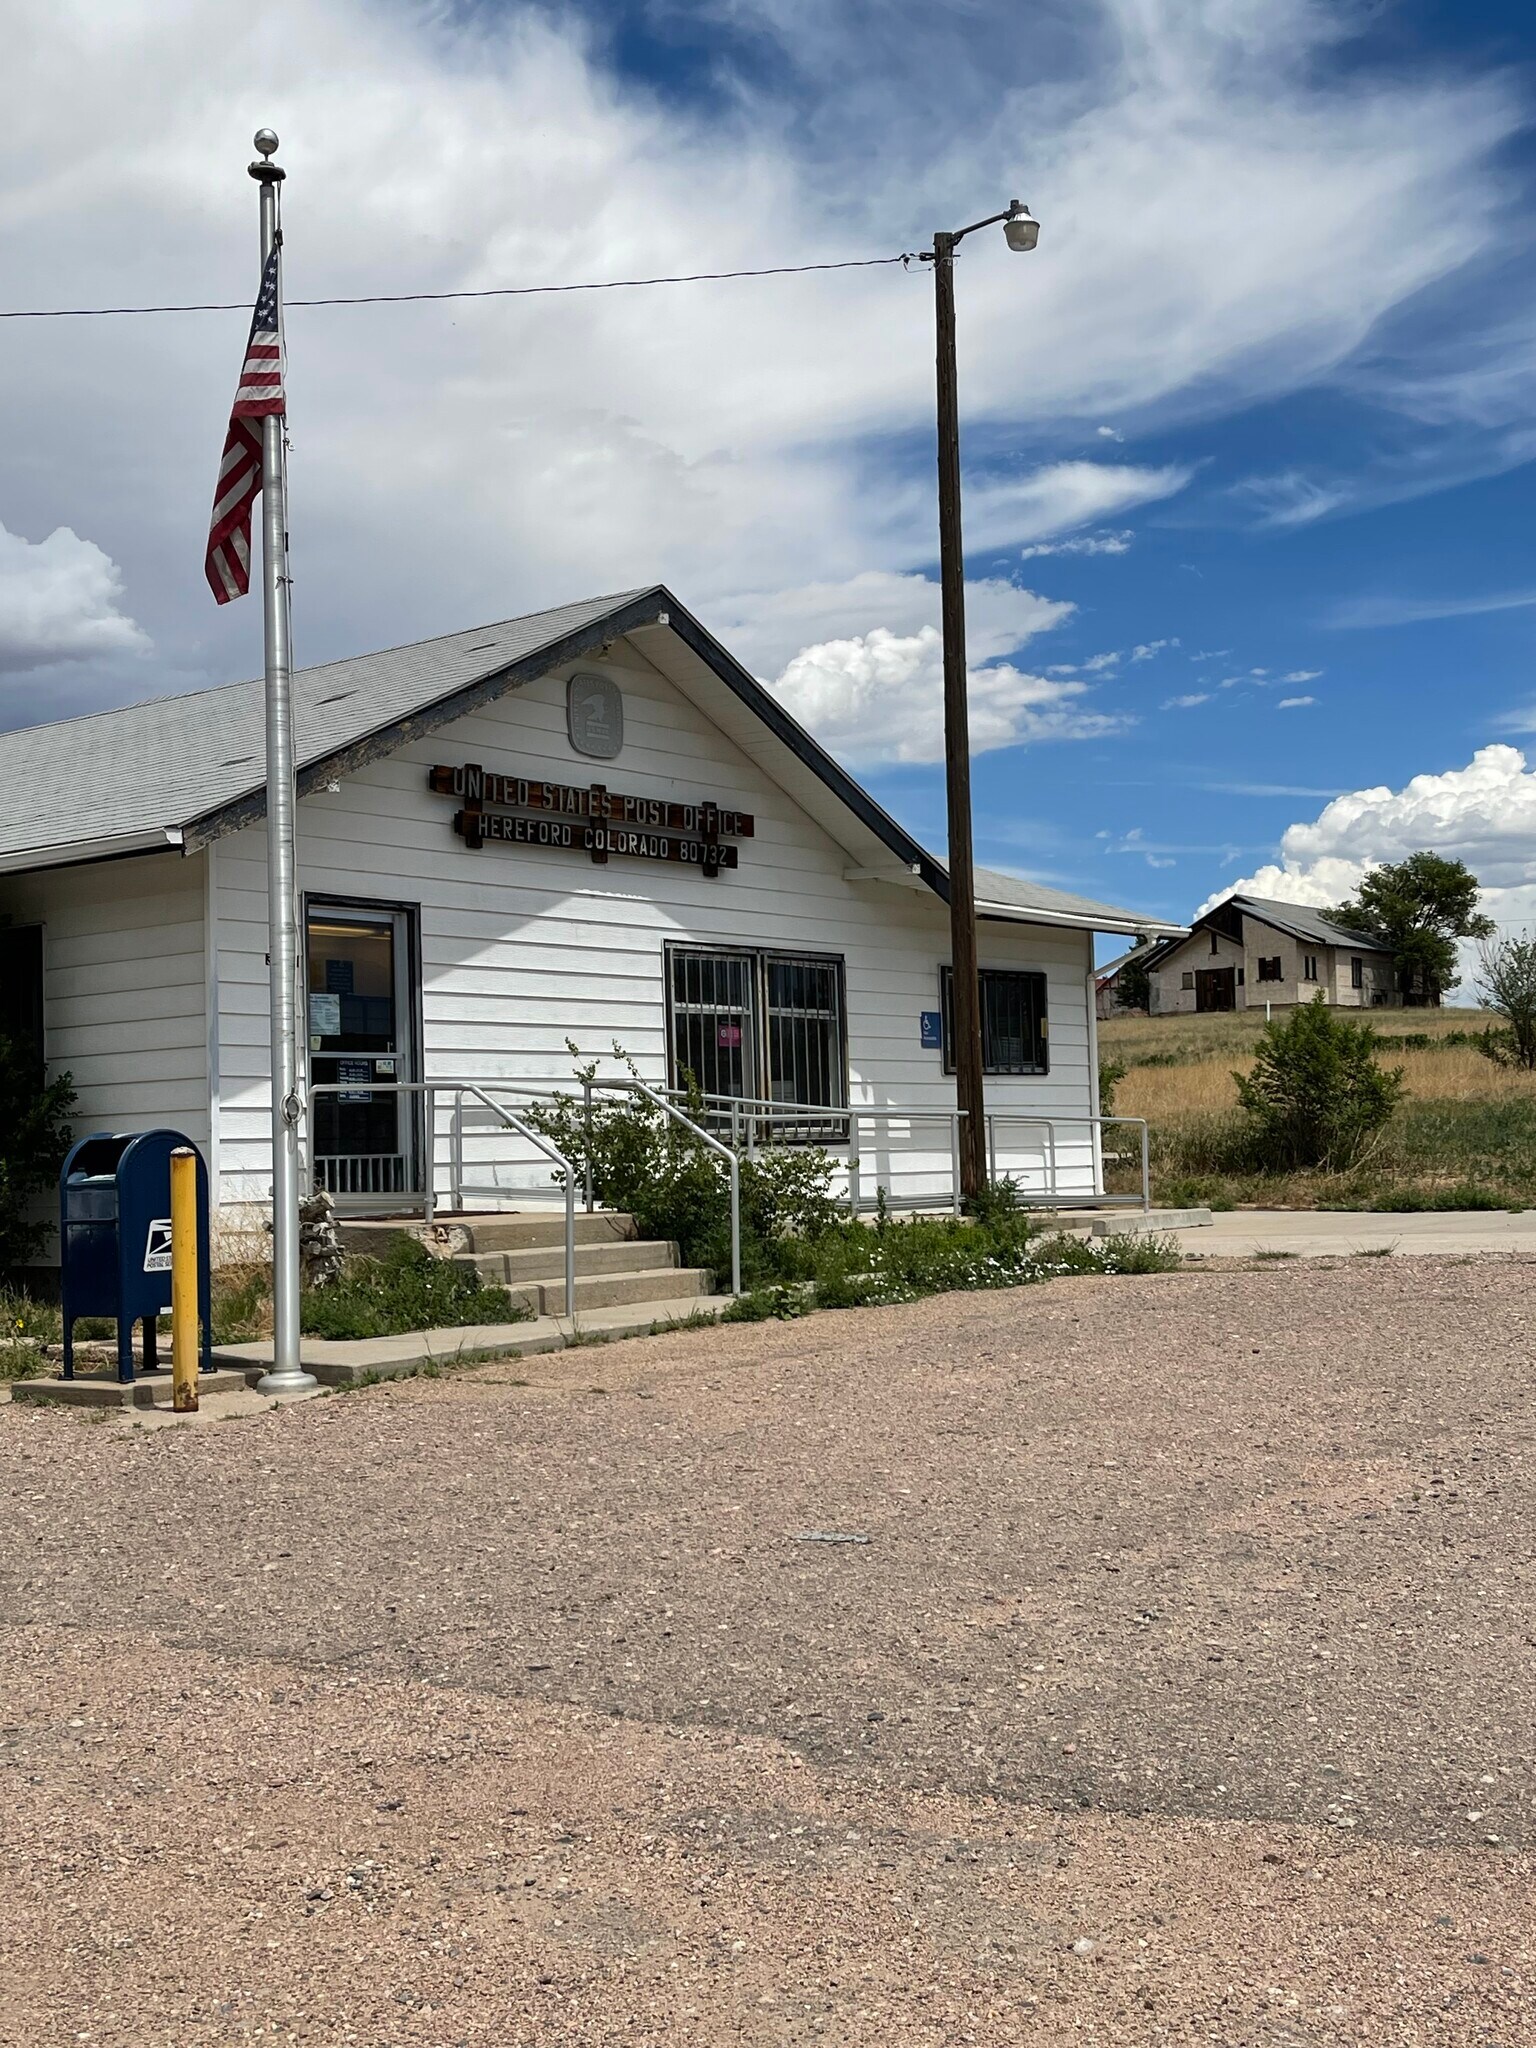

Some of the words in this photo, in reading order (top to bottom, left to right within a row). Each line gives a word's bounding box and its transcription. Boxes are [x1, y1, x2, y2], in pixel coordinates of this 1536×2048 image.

[453, 767, 529, 806] UNITED
[542, 782, 611, 818] STATES
[624, 796, 672, 827] POST
[683, 806, 744, 836] OFFICE
[478, 814, 572, 846] HEREFORD
[584, 828, 668, 858] COLORADO
[680, 841, 727, 865] 80732
